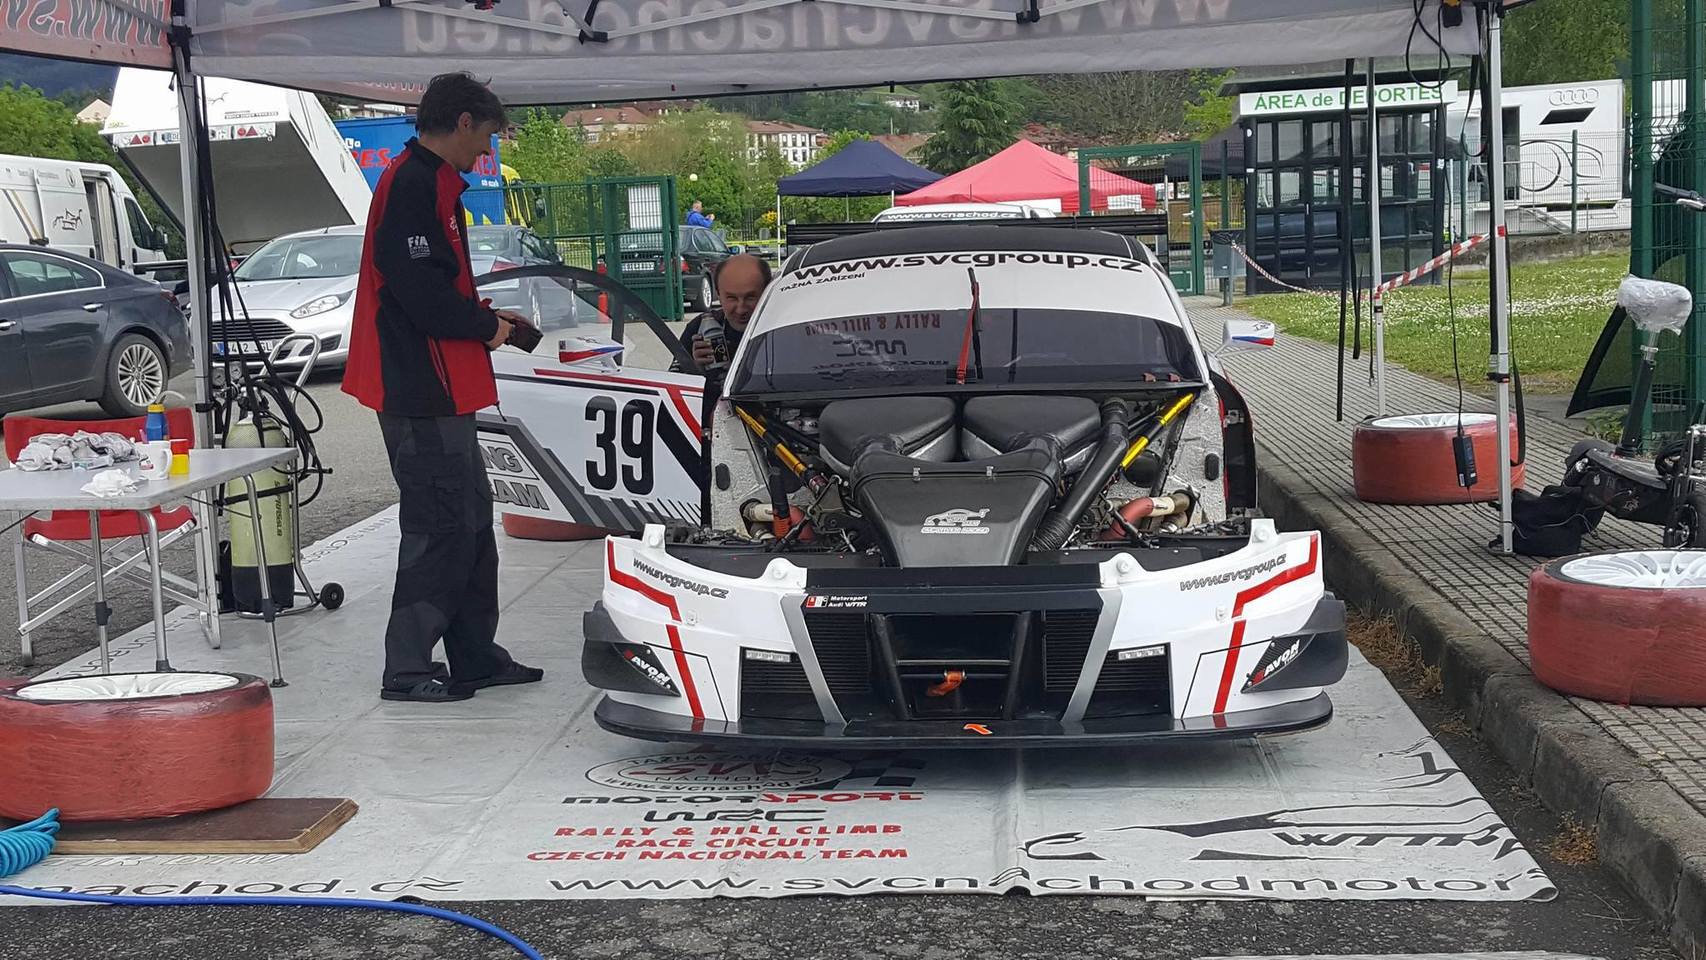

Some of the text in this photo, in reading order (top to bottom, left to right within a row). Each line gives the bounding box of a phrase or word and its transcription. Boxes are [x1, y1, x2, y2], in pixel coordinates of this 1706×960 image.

[1254, 86, 1442, 111] ÁREA de DEORTES
[794, 252, 1143, 280] www.svcgroup.cz
[585, 395, 655, 495] 39
[632, 557, 730, 599] www.svcgroup.cz
[1179, 553, 1287, 591] www.svcgroup.cz
[631, 656, 671, 683] AVON
[1264, 639, 1300, 677] AVON
[553, 824, 903, 837] RALLY & HILL CLIMB
[615, 836, 831, 849] RACE CIRCUIT
[526, 848, 909, 862] CZECH NACIONAL TEAM
